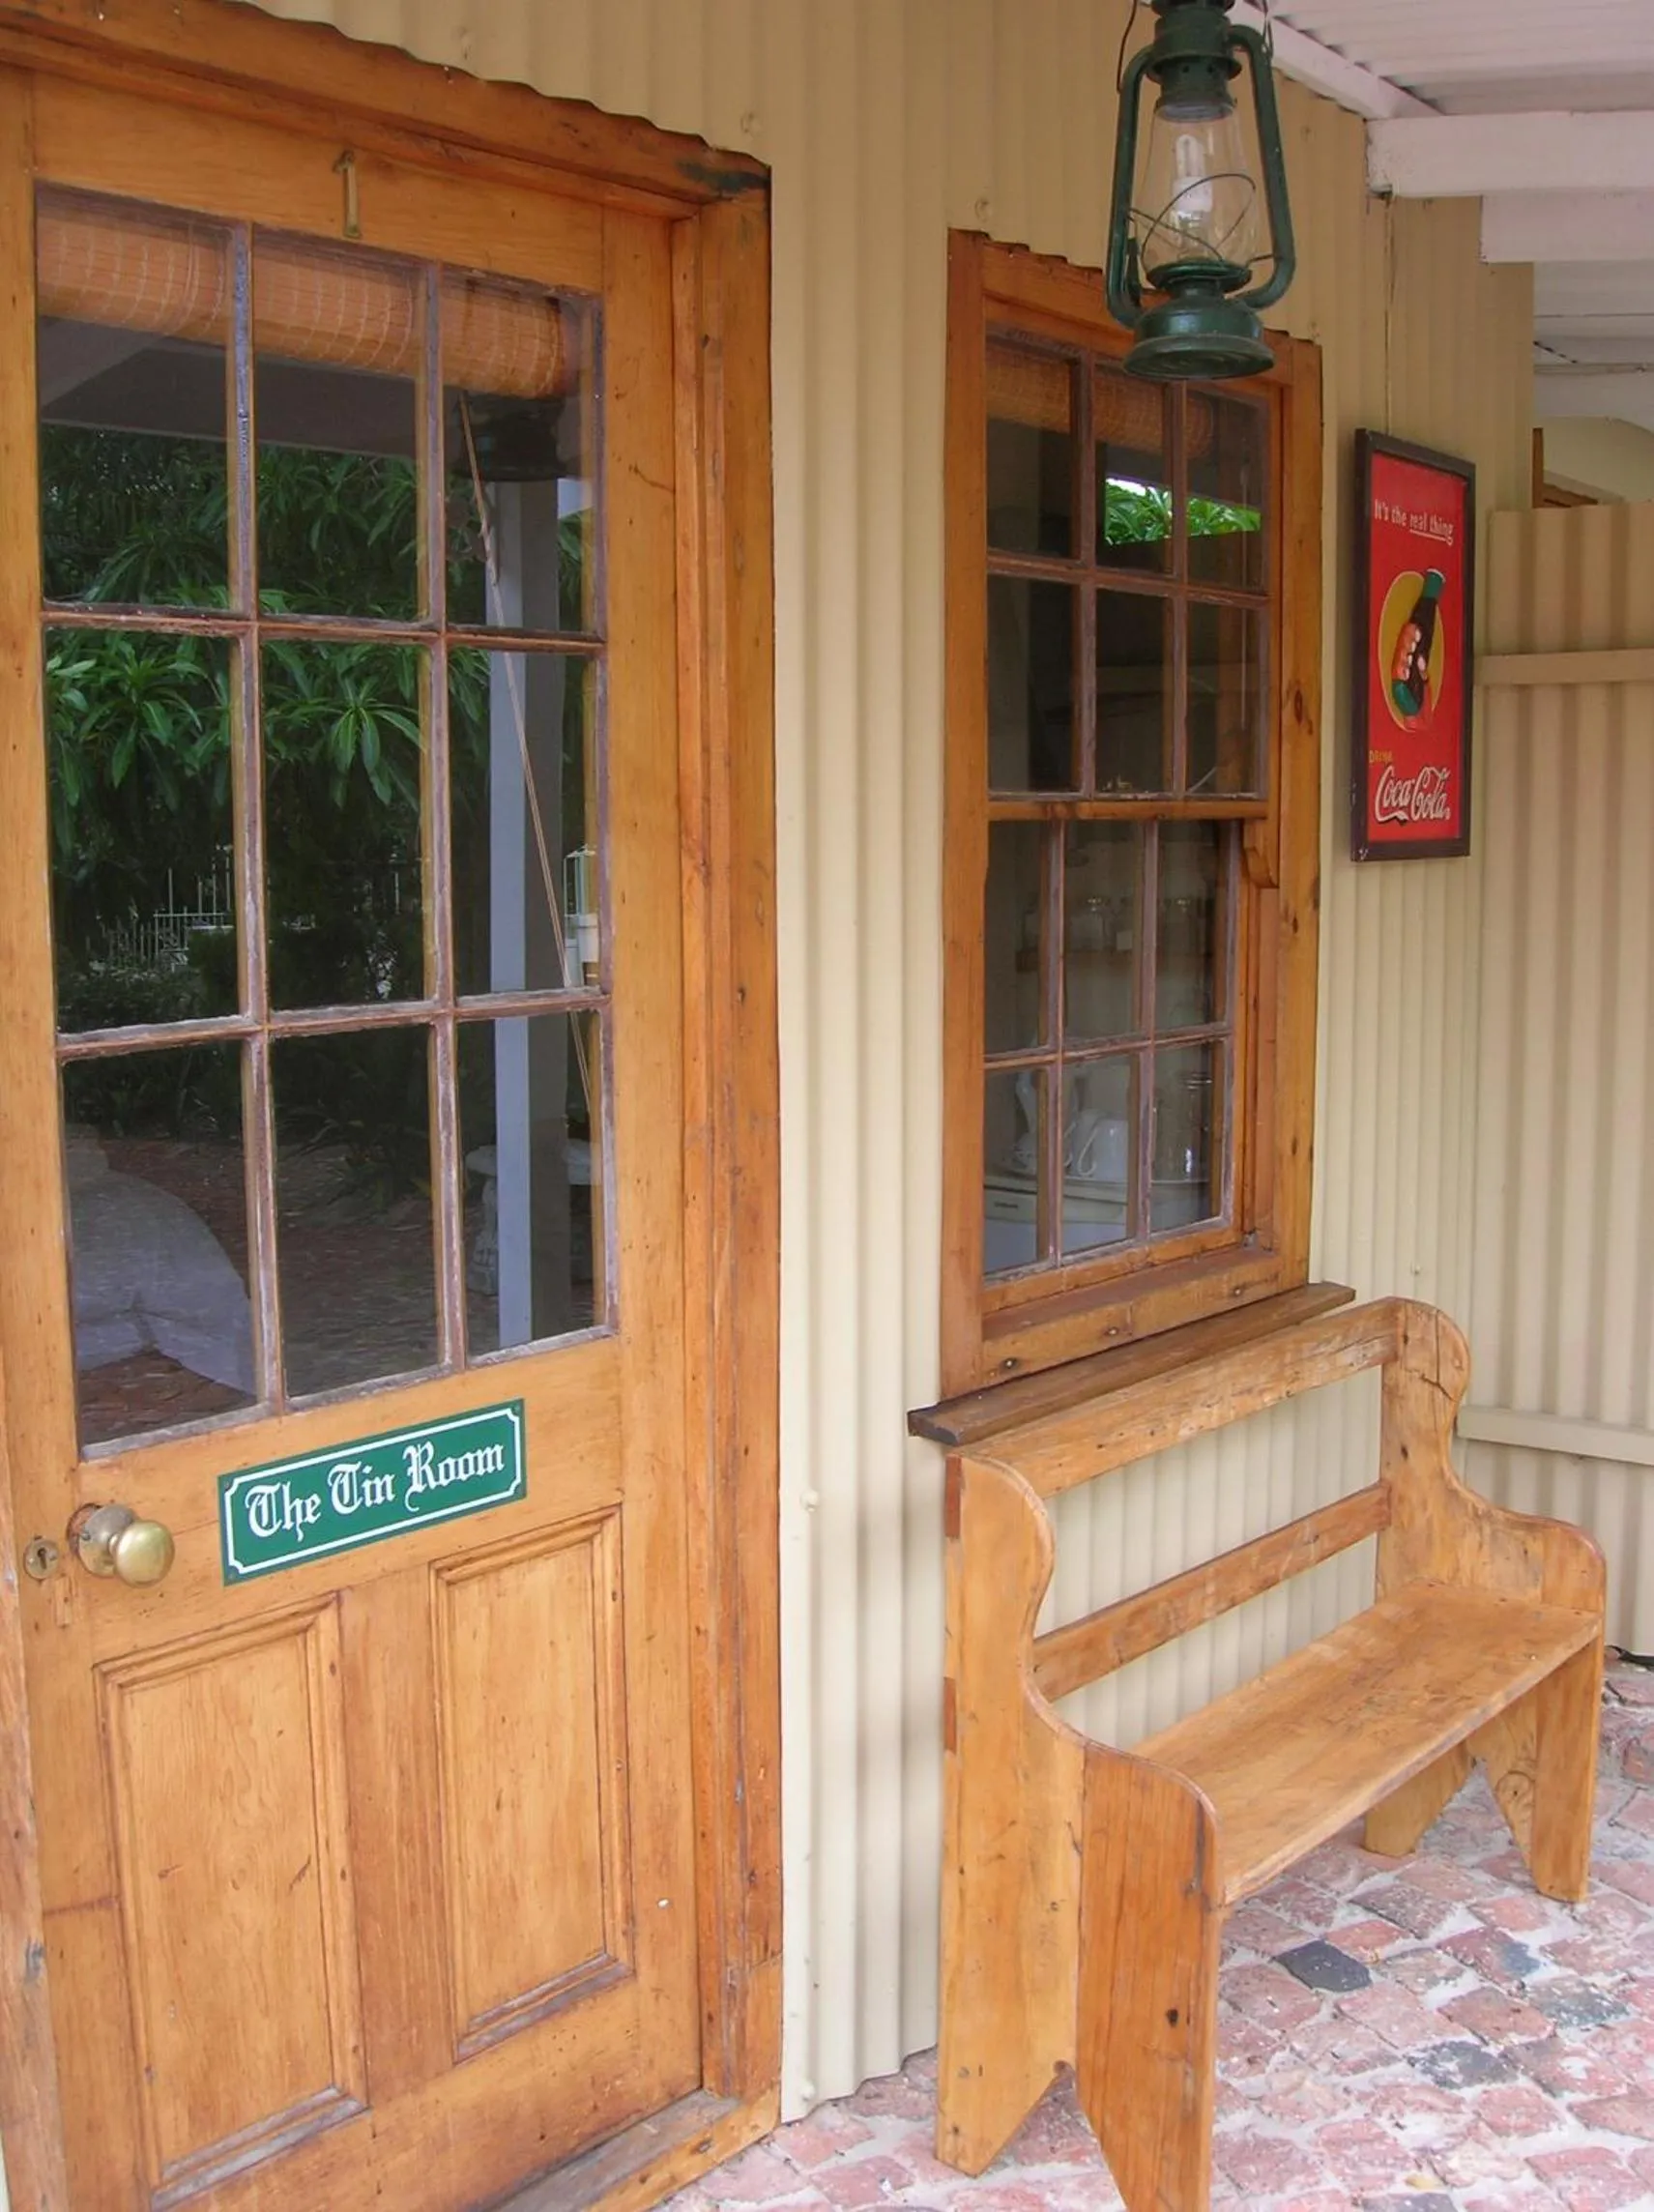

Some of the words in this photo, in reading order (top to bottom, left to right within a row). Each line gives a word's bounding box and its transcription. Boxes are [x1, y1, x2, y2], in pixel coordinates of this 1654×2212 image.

[1374, 498, 1389, 522] It's
[1391, 506, 1407, 527] the
[1409, 511, 1428, 532] real
[1430, 513, 1454, 546] thing
[245, 1481, 322, 1543] The
[327, 1460, 395, 1515] Tin
[402, 1441, 505, 1512] Room
